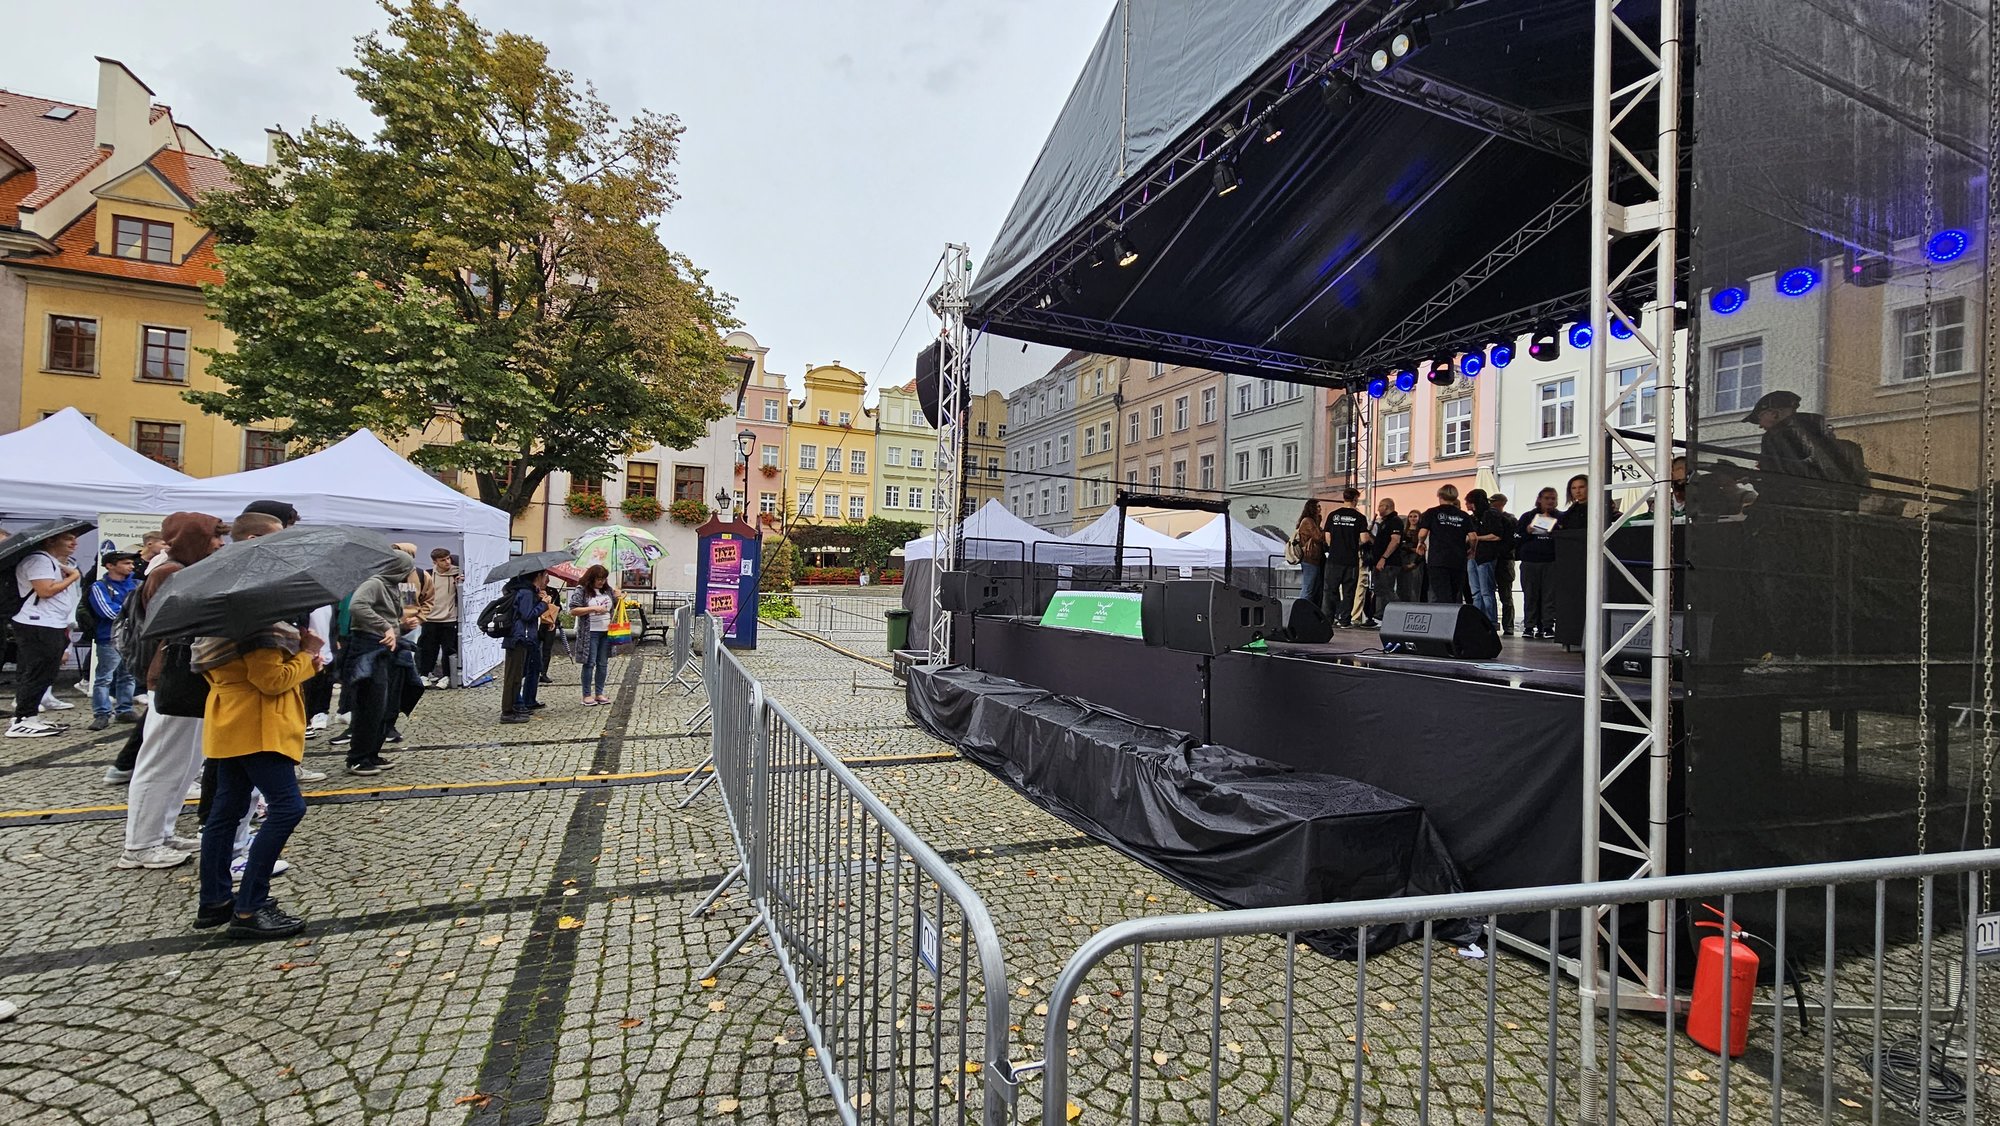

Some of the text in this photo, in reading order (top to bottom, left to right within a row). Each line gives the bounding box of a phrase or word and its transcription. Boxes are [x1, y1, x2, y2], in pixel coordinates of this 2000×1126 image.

[715, 549, 736, 558] JAZZ
[711, 599, 732, 607] JAZZ
[1407, 614, 1427, 624] POL
[1406, 623, 1426, 631] AUDIO
